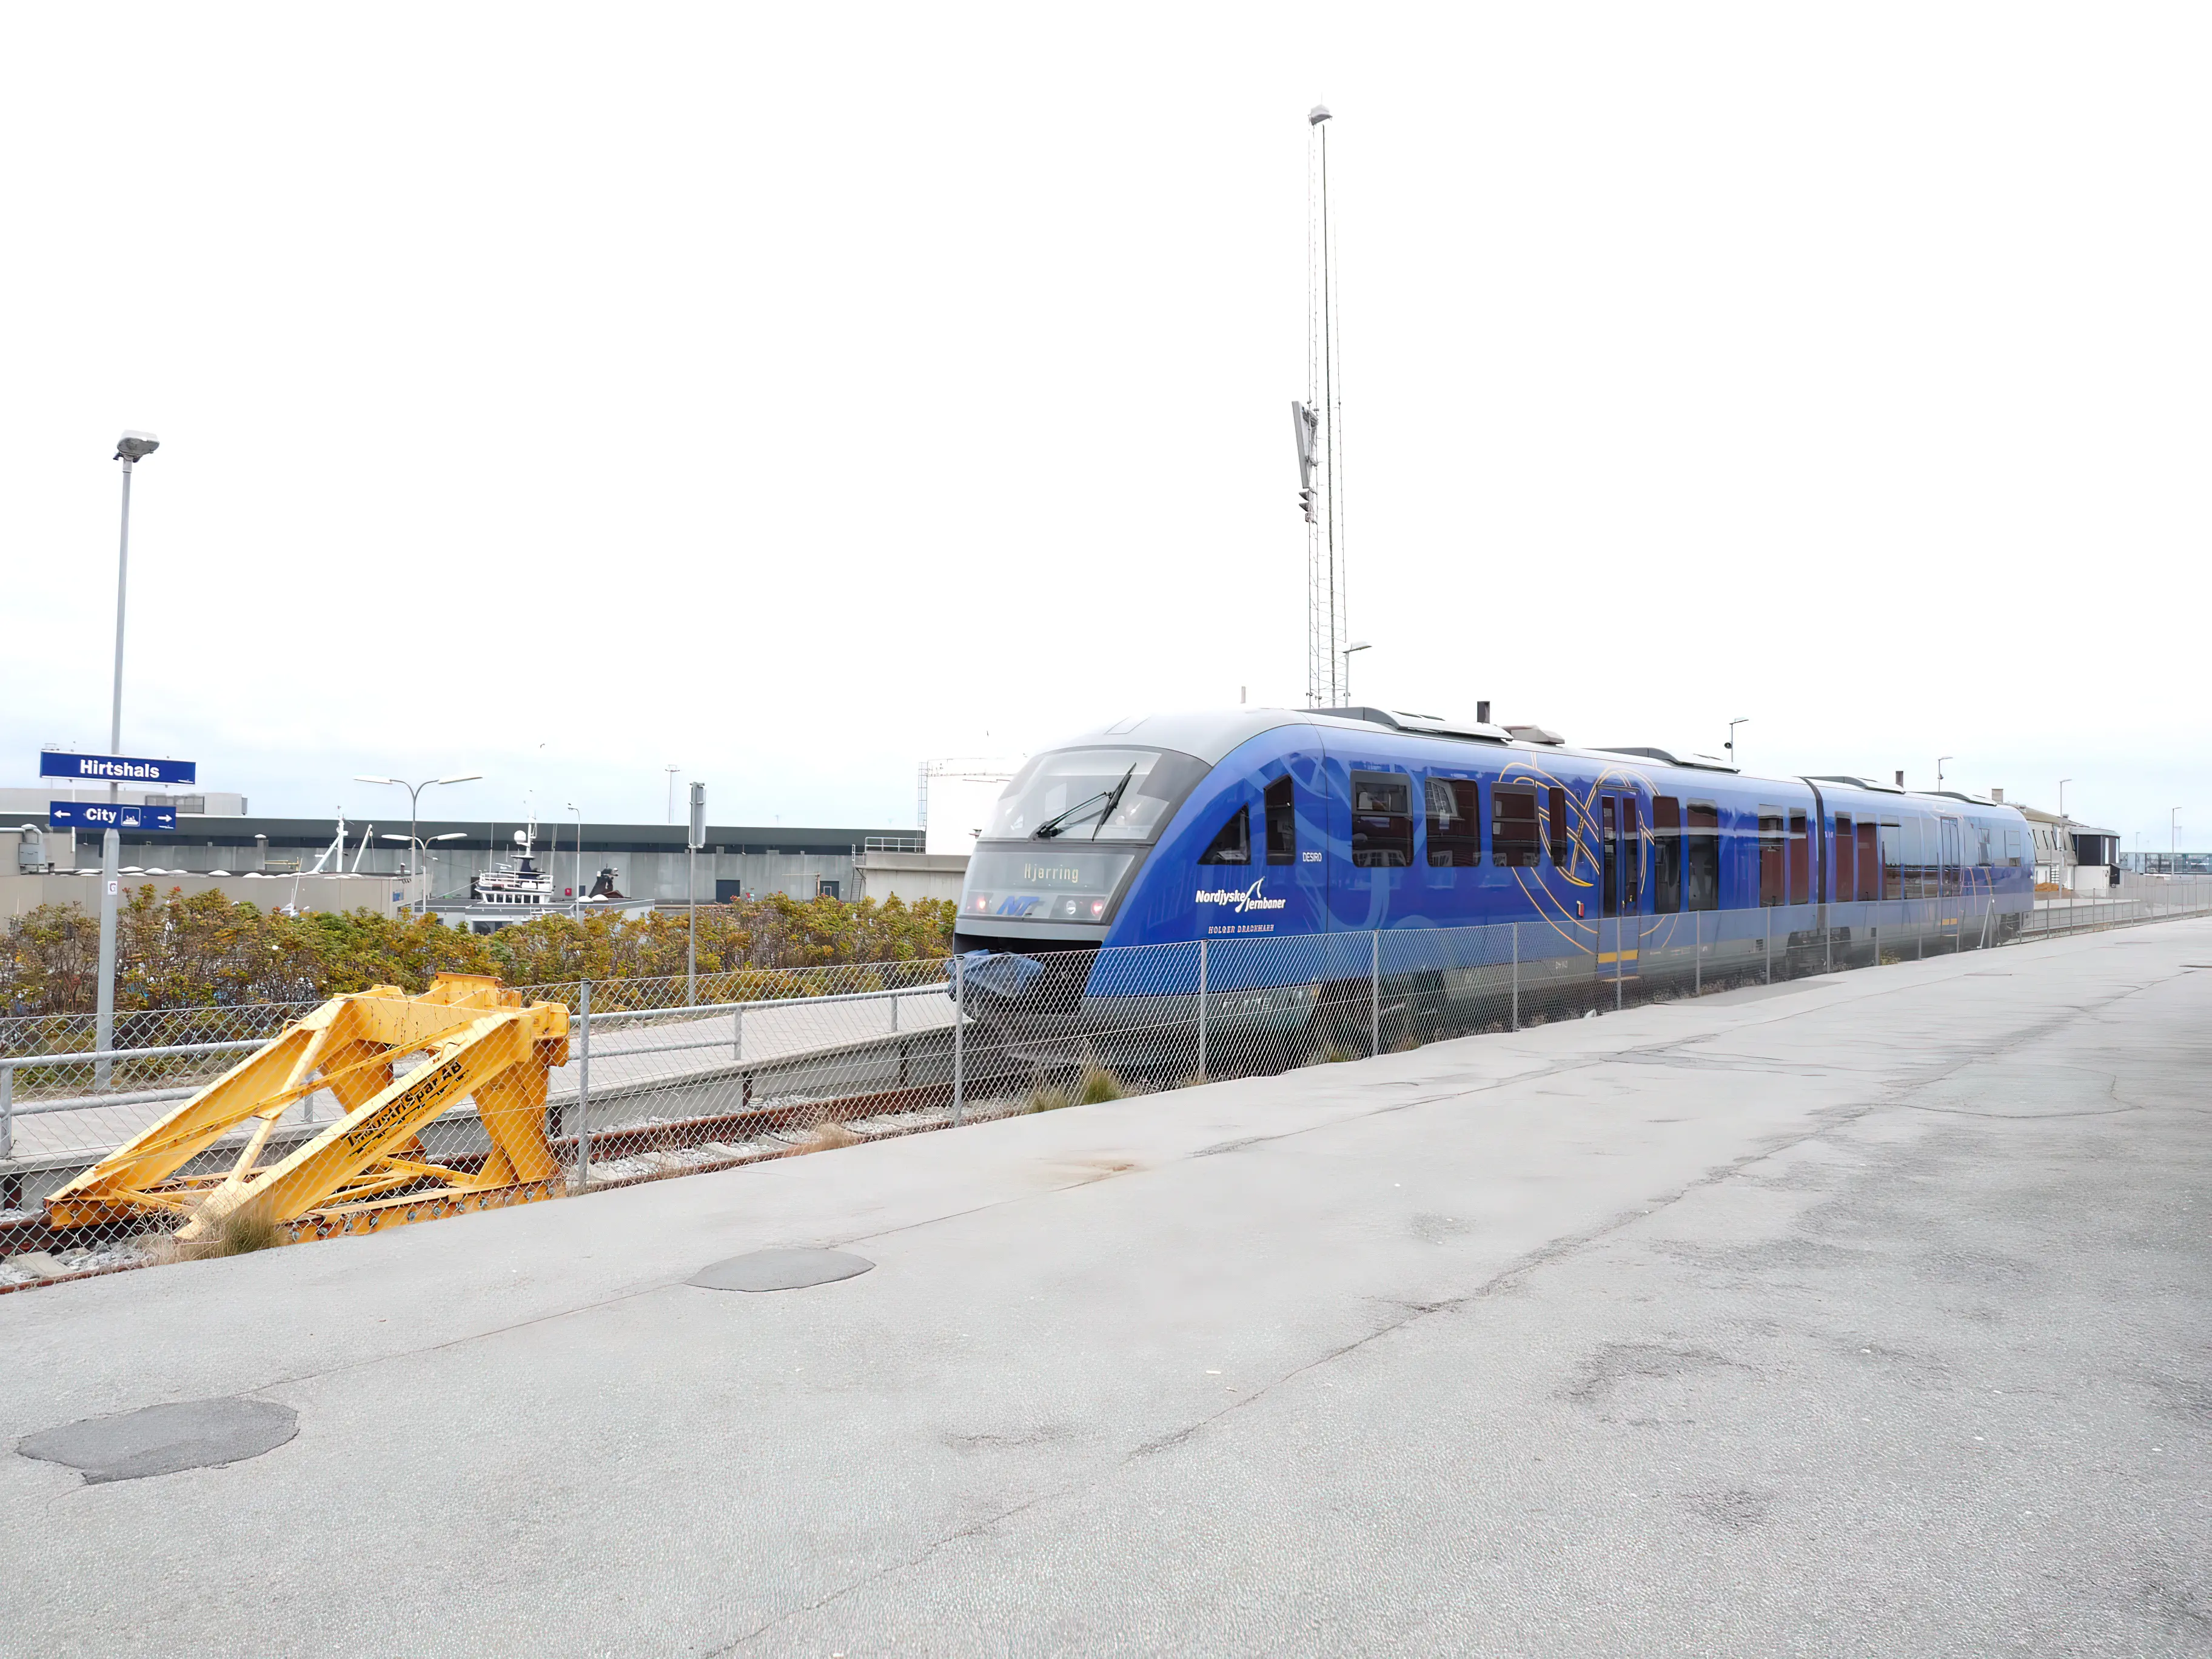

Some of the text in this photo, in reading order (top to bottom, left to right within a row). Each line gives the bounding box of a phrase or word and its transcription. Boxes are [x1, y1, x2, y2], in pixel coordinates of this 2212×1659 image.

[80, 759, 159, 778] Hirtshals
[86, 808, 116, 823] City
[1302, 852, 1322, 862] DESIRO
[1024, 863, 1079, 883] Hjørring
[1195, 889, 1245, 905] Nordjyske
